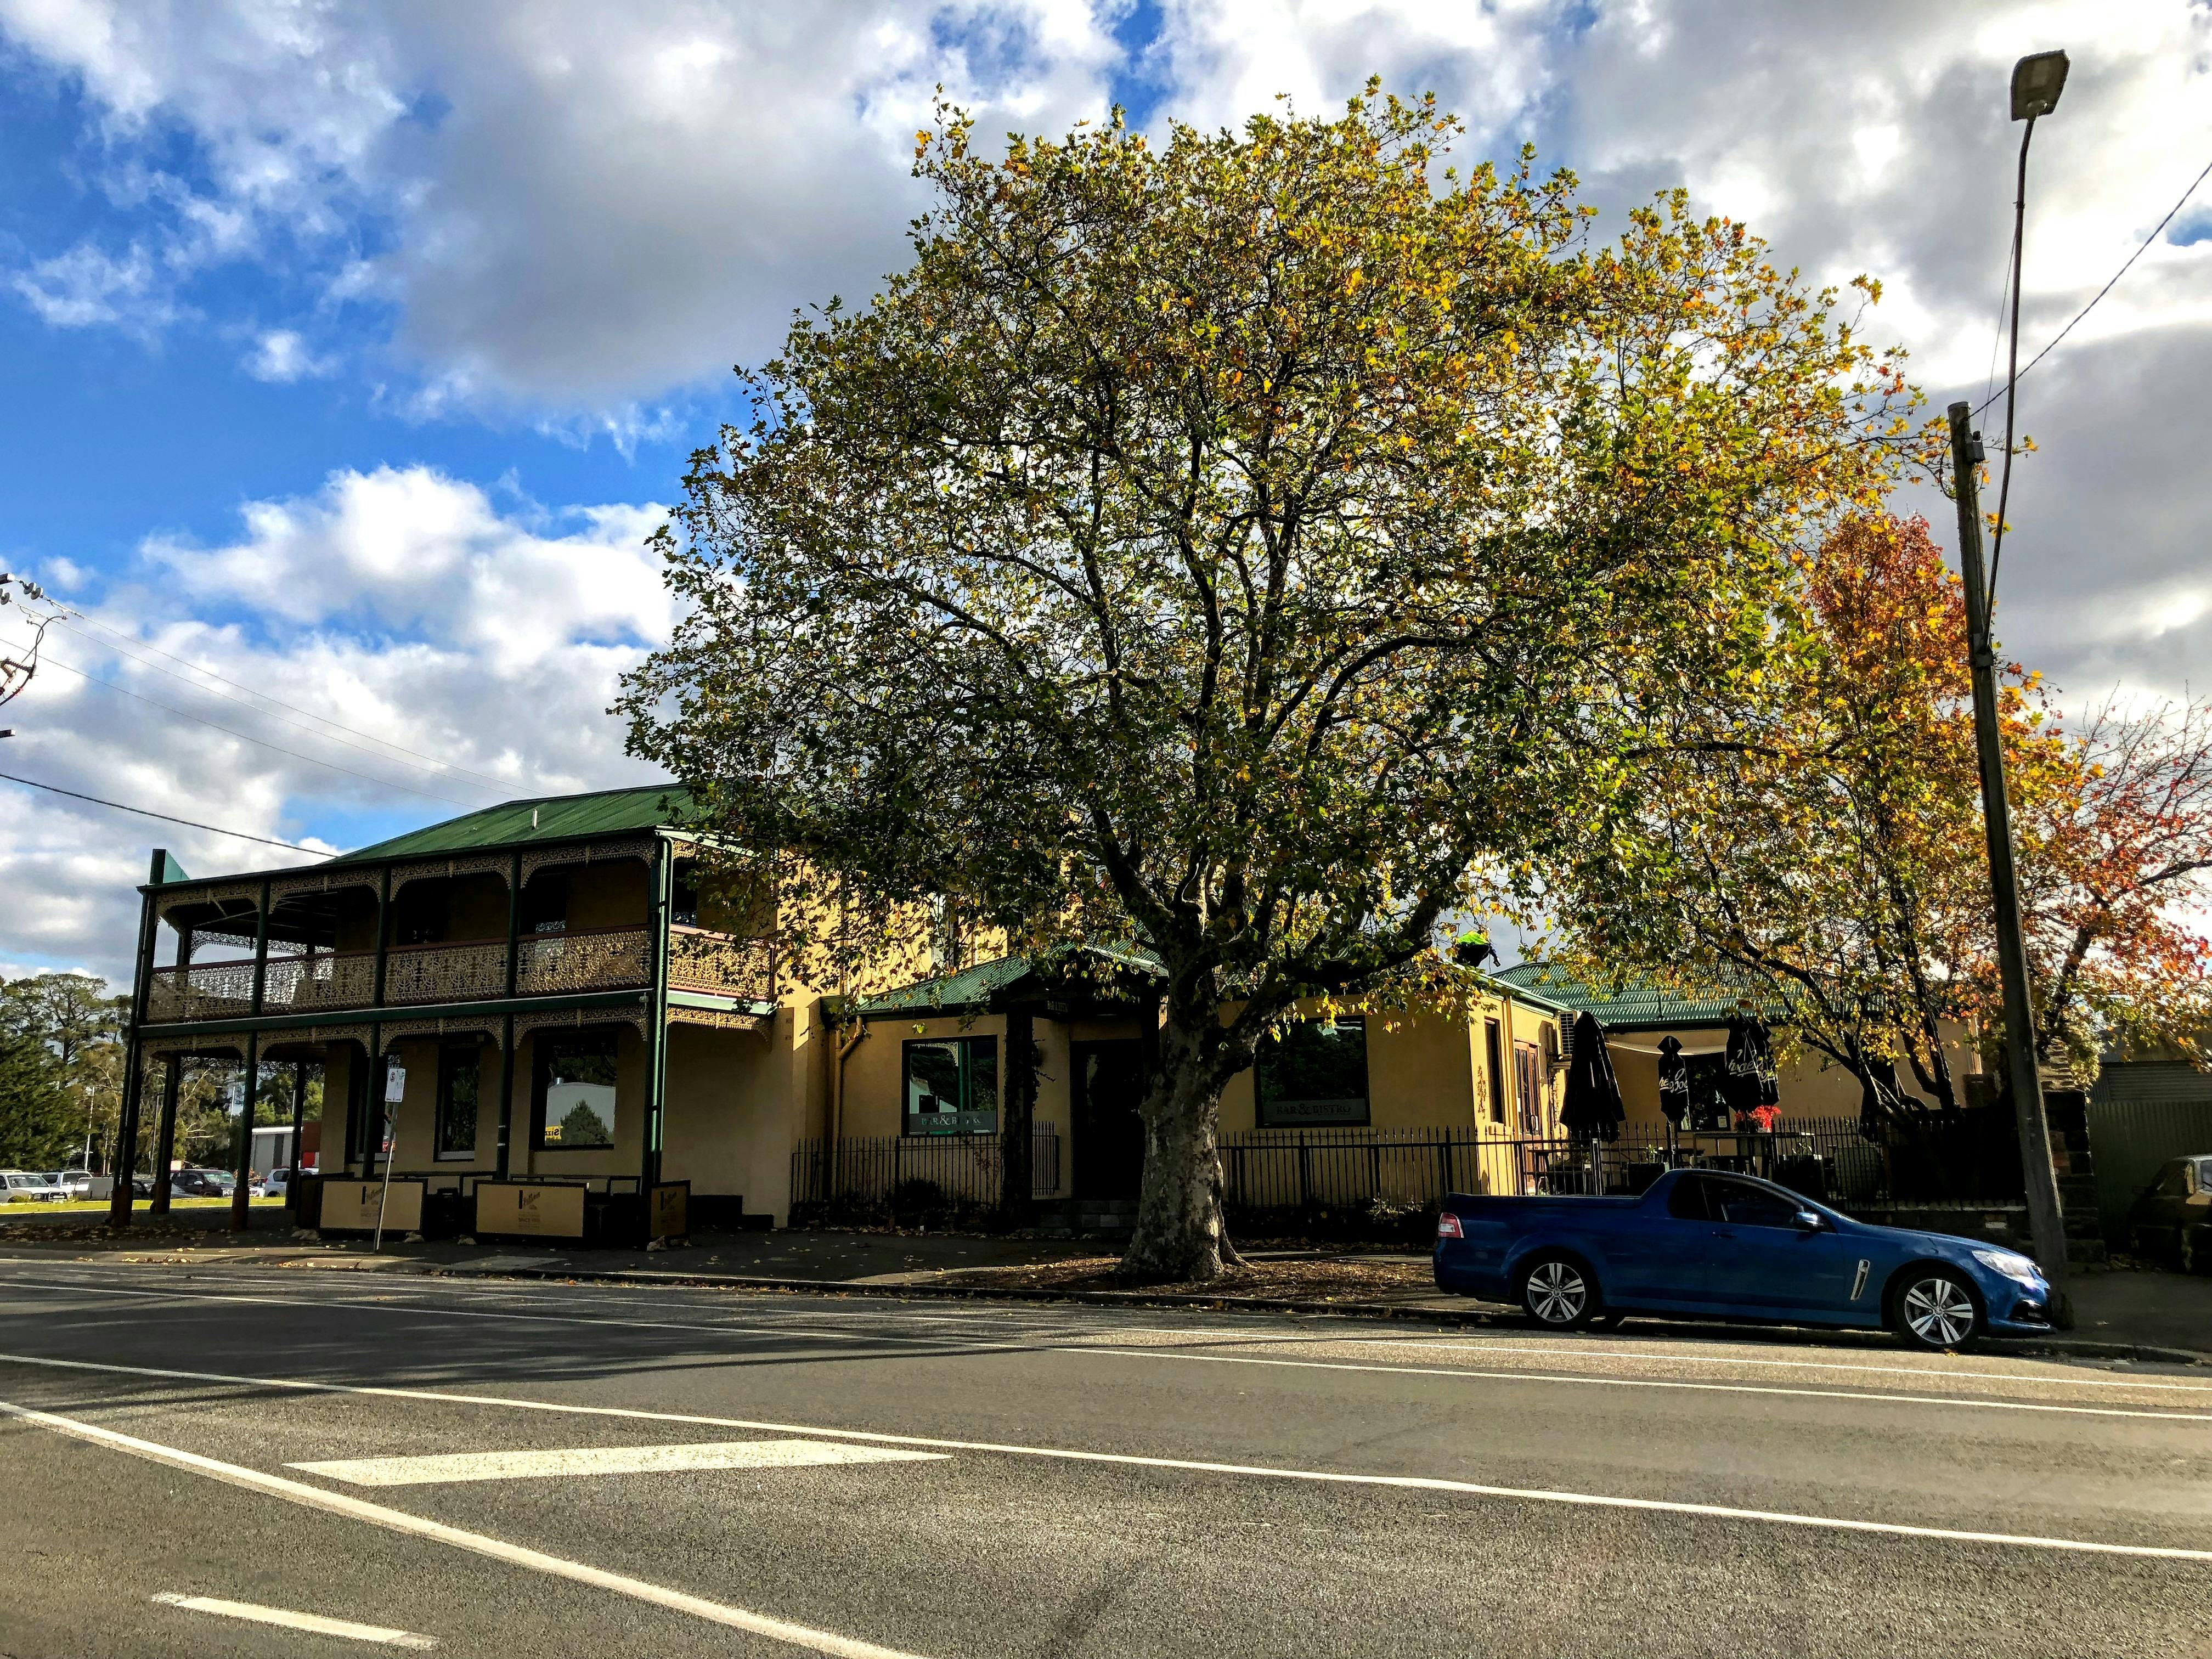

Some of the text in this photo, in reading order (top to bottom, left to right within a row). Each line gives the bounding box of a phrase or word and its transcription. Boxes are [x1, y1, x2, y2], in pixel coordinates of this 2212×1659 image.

[1277, 1105, 1296, 1115] BAR
[1298, 1103, 1311, 1115] &
[940, 1115, 951, 1125] &
